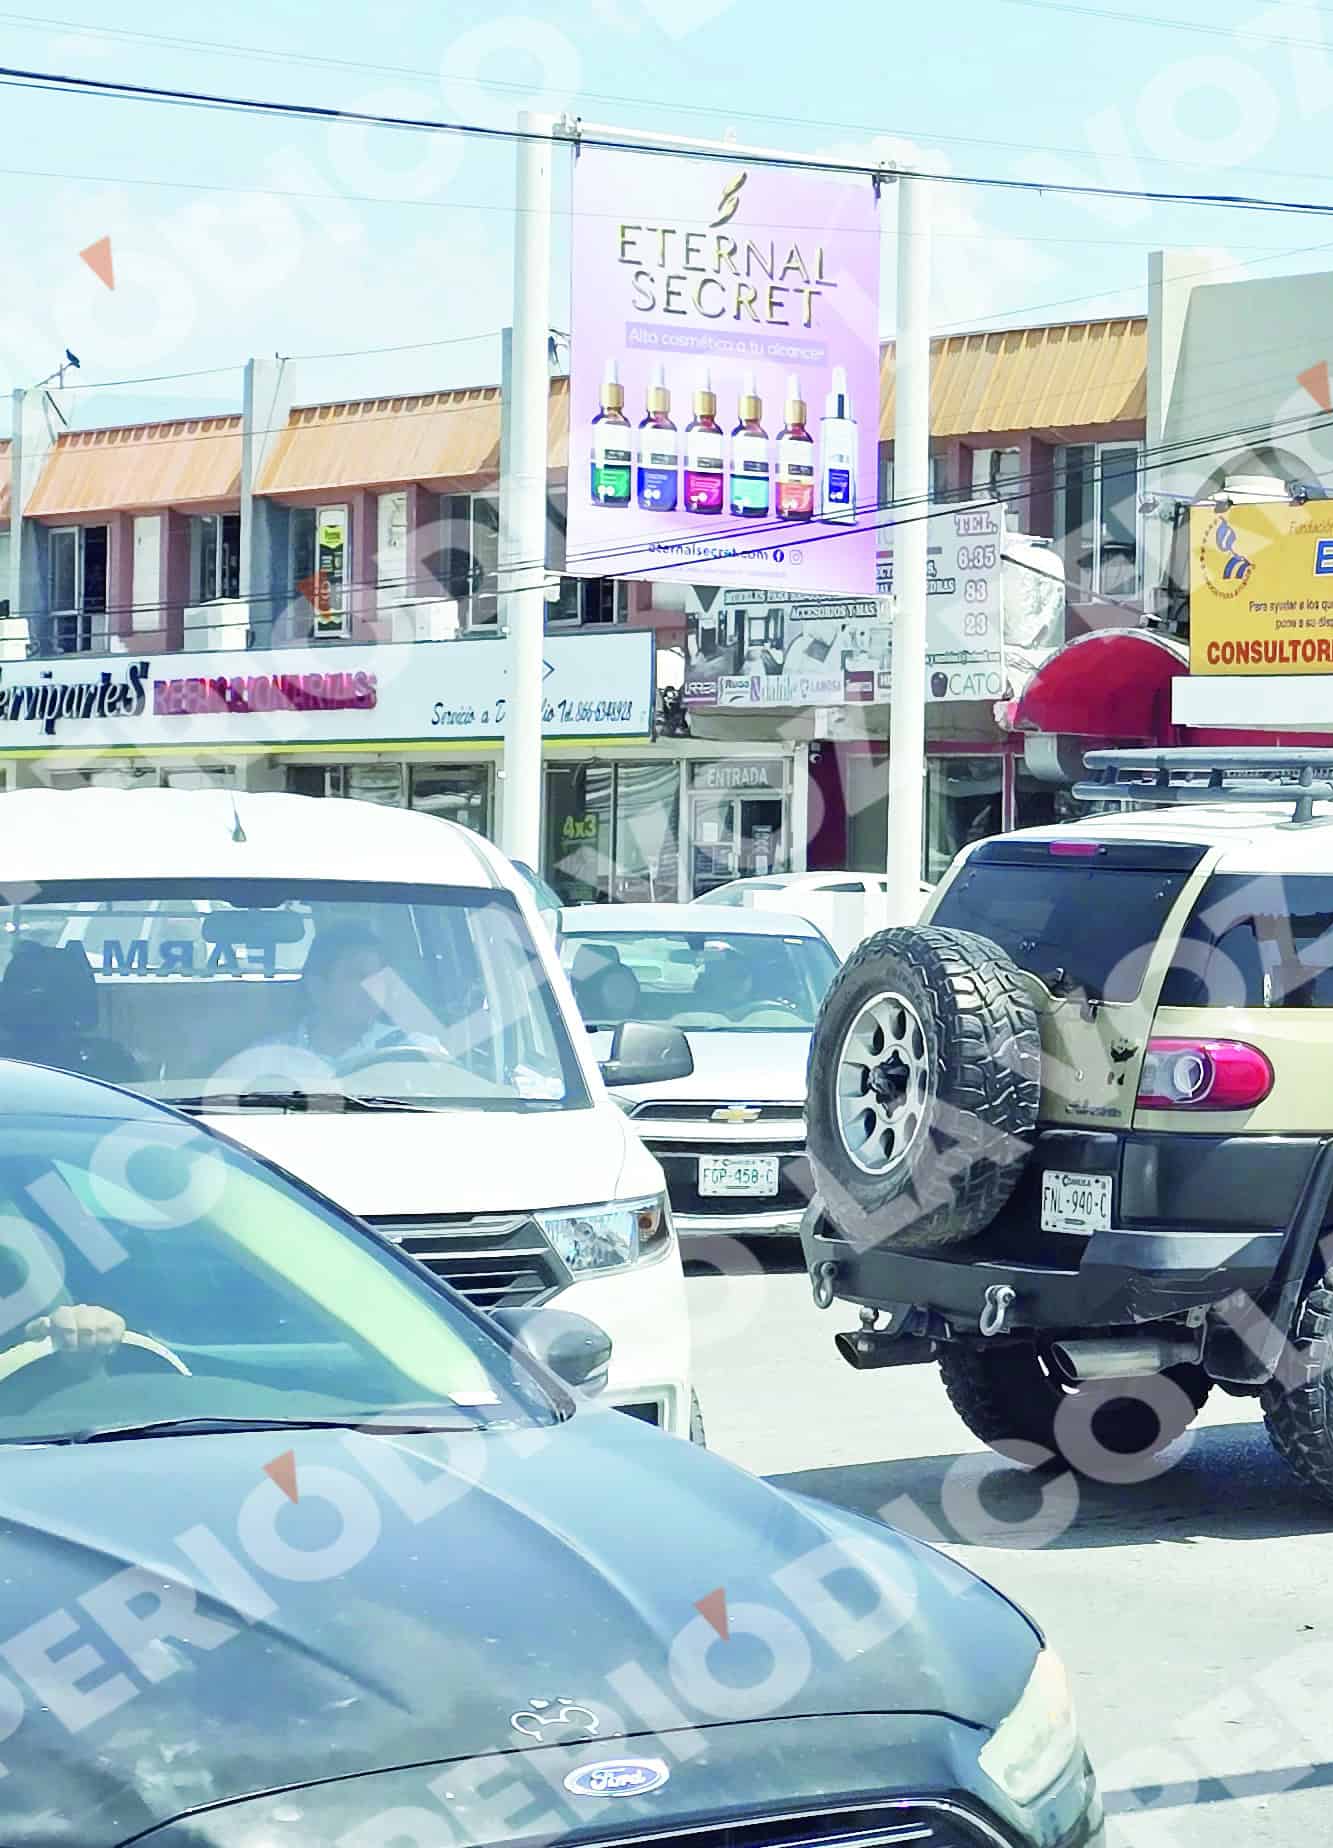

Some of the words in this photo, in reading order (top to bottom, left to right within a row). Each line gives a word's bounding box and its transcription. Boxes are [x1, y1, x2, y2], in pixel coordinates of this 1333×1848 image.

[618, 225, 838, 287] ETERNAL
[632, 270, 822, 328] SECRET
[628, 328, 656, 345] Alta
[954, 511, 998, 536] TEL.
[1249, 600, 1268, 612] Para
[1269, 600, 1298, 615] ayudar
[1306, 599, 1320, 610] los
[706, 767, 768, 787] ENTRADA
[562, 814, 598, 840] 4x3
[1043, 1186, 1107, 1218] FNL-940-C
[590, 1769, 647, 1791] Ford
